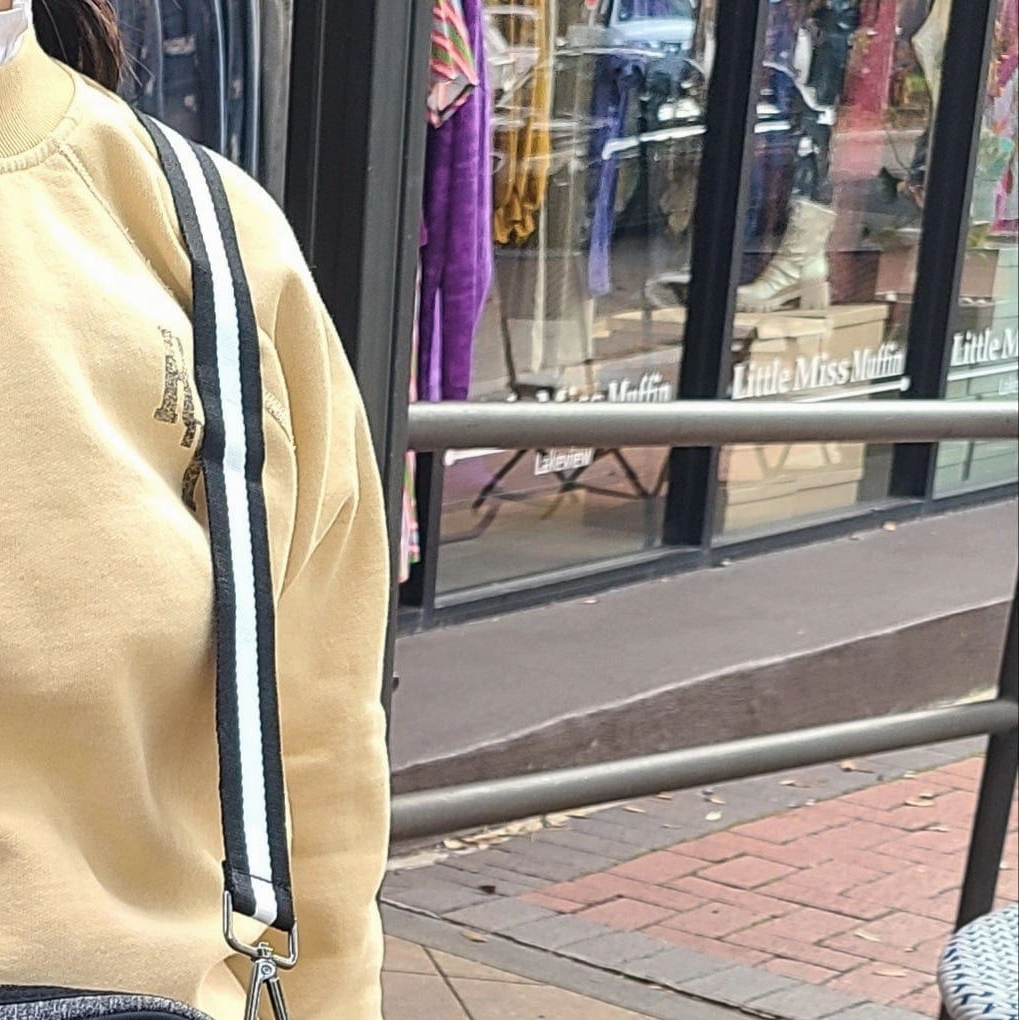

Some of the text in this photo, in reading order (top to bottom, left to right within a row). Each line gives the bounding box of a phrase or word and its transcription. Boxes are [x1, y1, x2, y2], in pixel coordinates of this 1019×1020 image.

[950, 326, 1001, 367] Little
[732, 340, 906, 400] Little Miss Muffin
[534, 446, 595, 476] Lakeview
